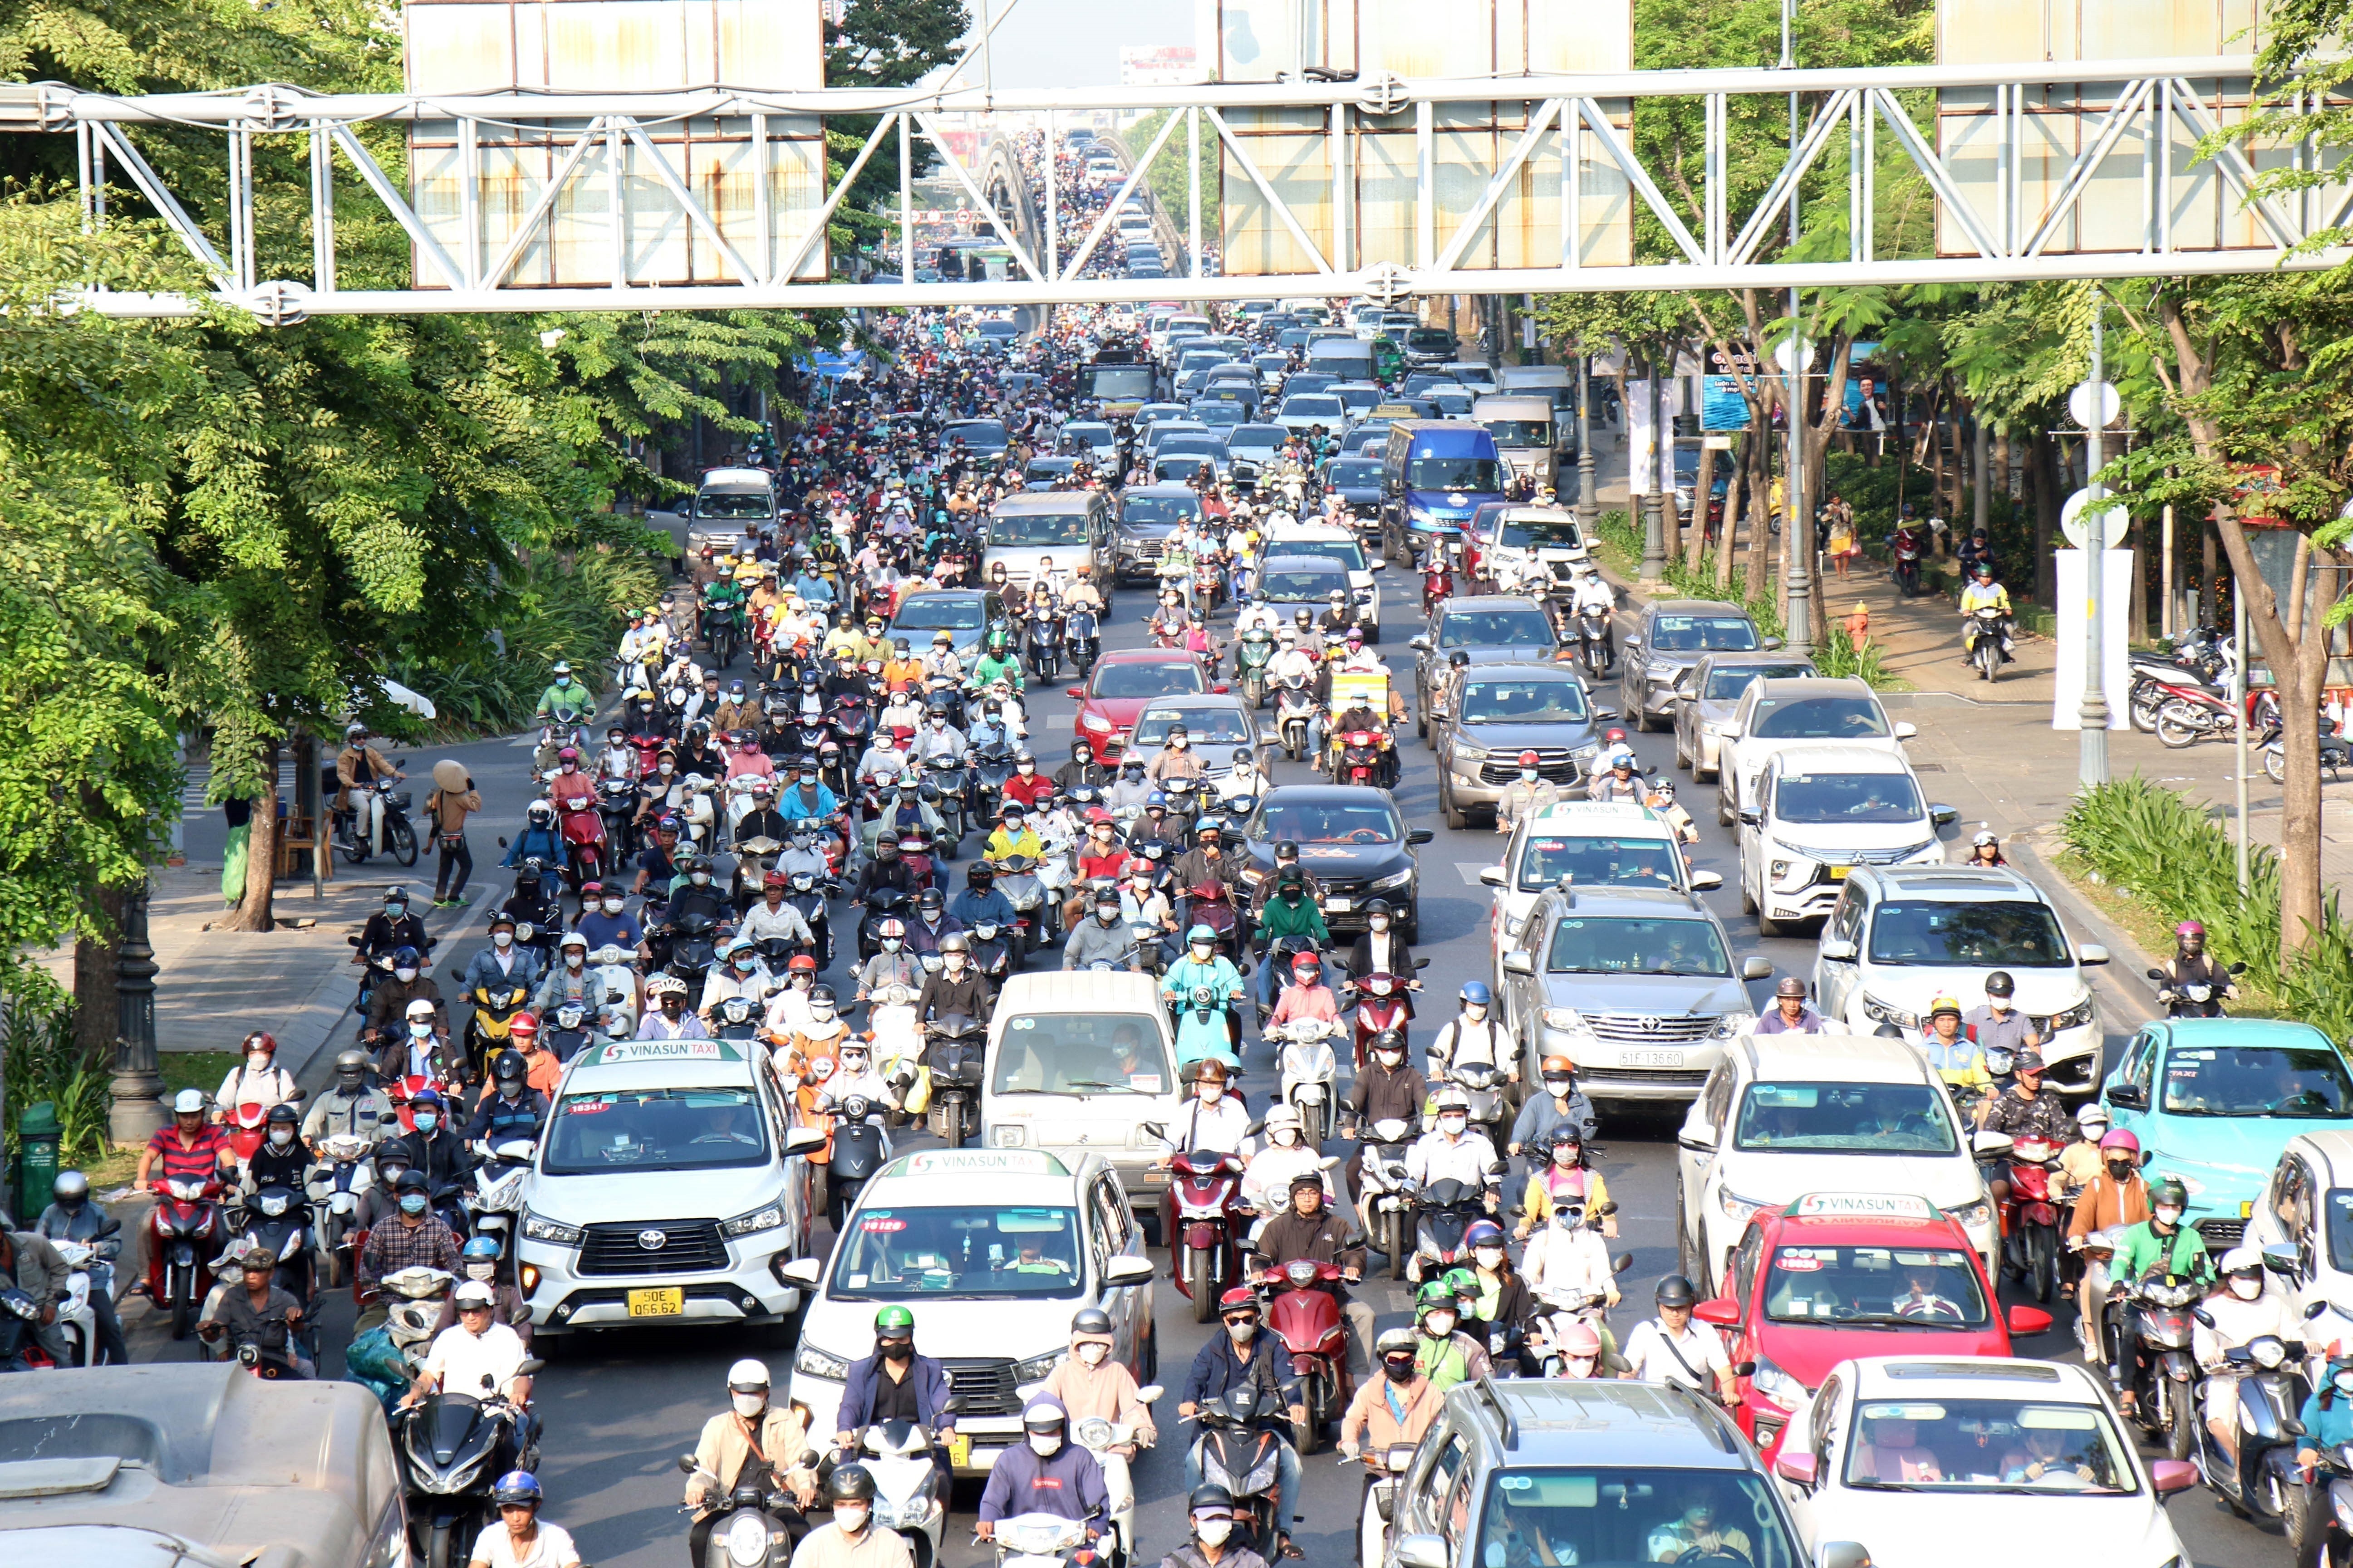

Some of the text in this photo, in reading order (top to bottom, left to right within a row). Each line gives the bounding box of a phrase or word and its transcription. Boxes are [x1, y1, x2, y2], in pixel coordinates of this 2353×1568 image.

[630, 1044, 716, 1056] VINASUN TAXI
[943, 1156, 1007, 1167] VINASUN
[1830, 1198, 1926, 1212] VINASUN TAXI
[644, 1291, 666, 1302] 50E
